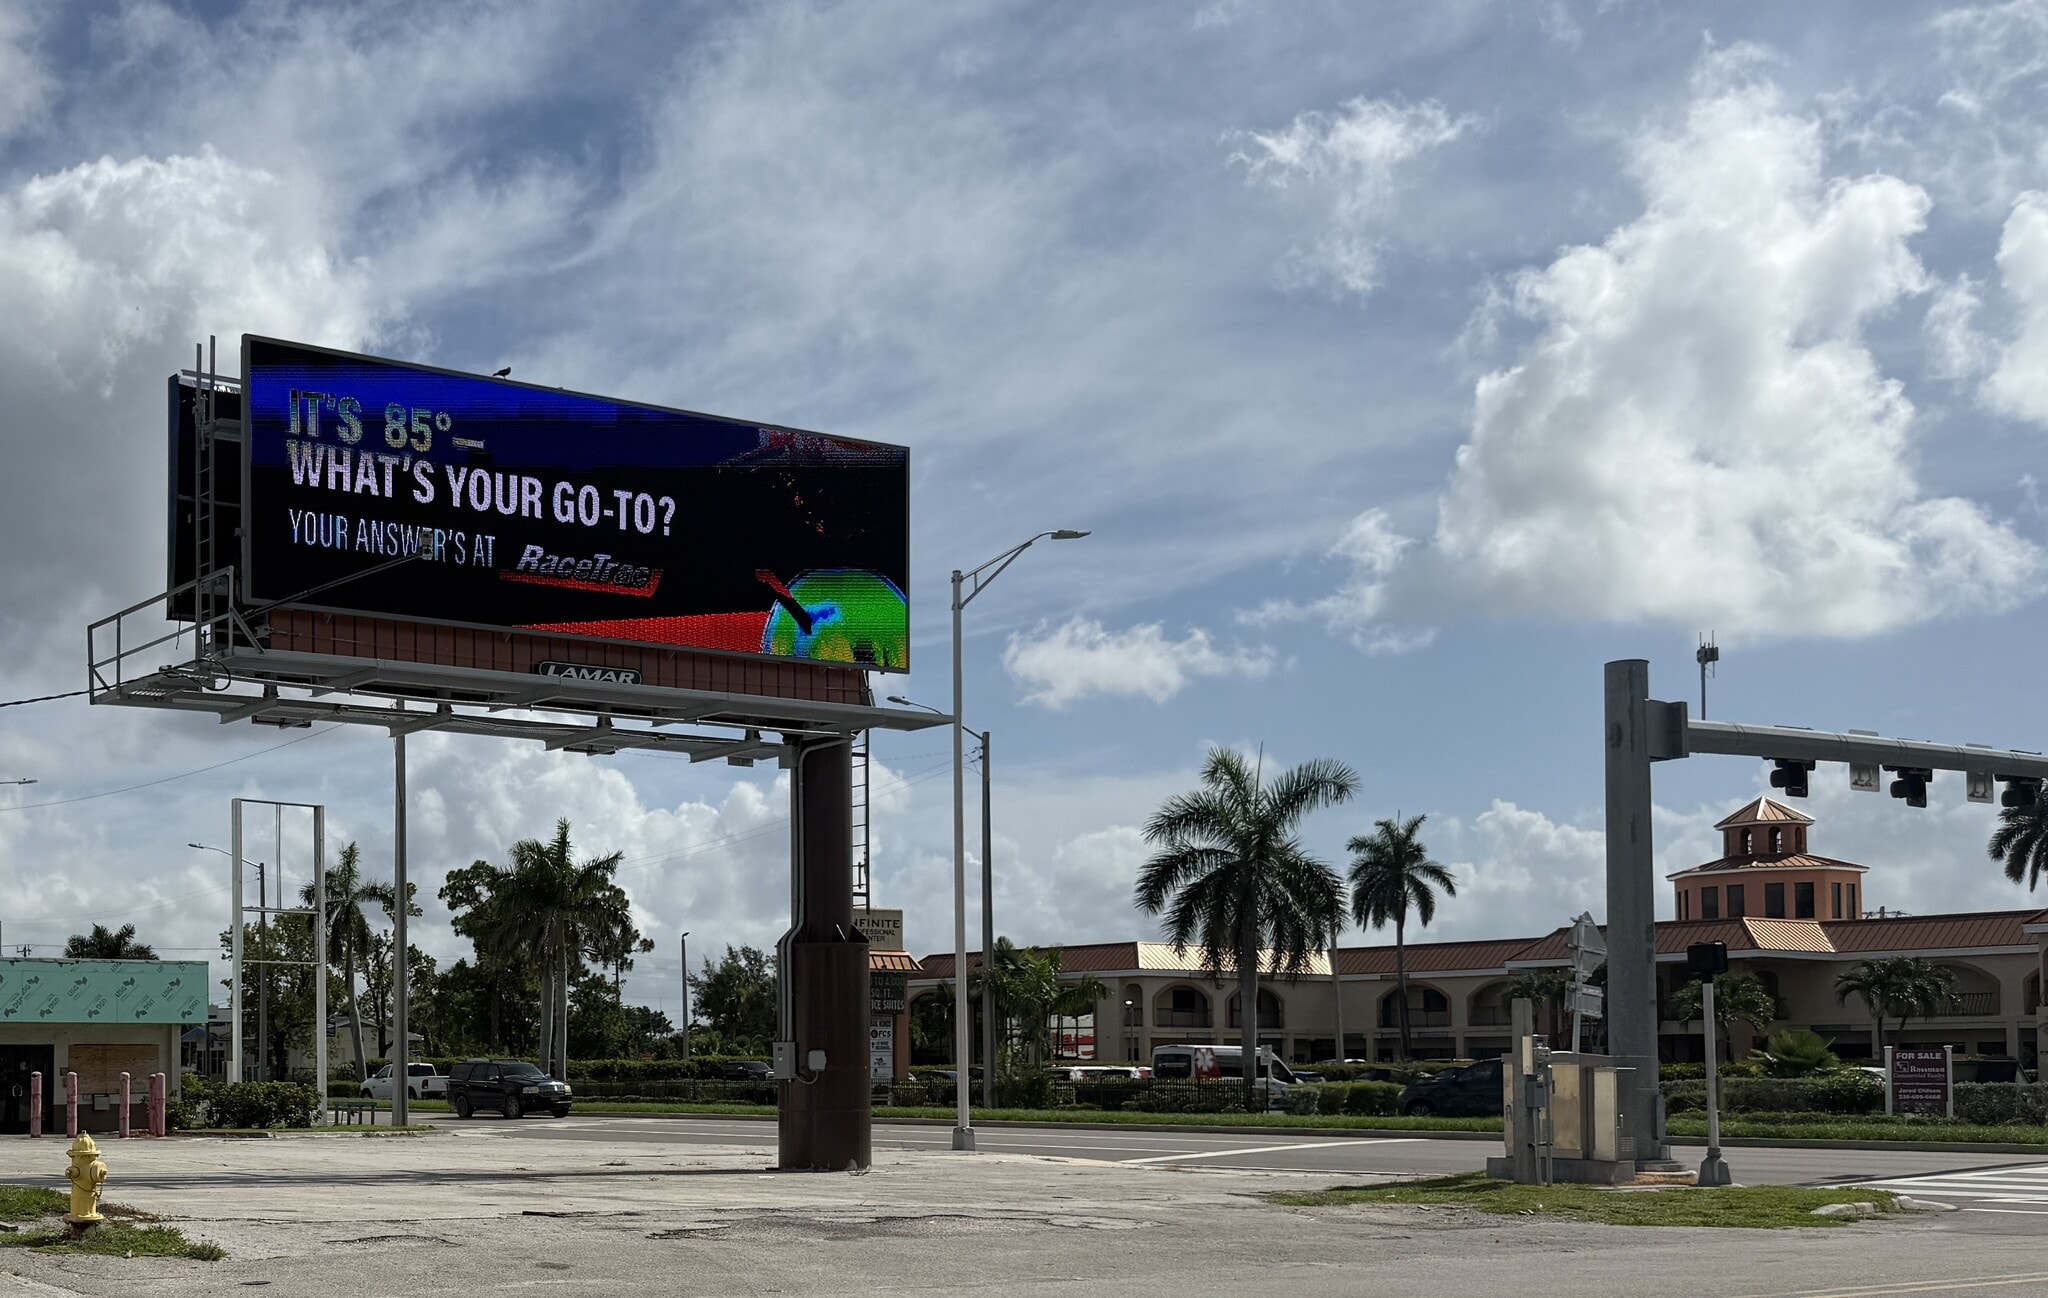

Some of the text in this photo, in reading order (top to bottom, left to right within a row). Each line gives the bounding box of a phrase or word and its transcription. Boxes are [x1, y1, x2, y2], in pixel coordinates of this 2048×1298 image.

[288, 388, 364, 445] IT'S
[286, 438, 676, 536] WHAT'S YOUR GO-TO?
[288, 508, 348, 550] YOUR
[472, 534, 496, 568] AT
[516, 544, 651, 587] RaceTrac
[547, 664, 635, 684] LAMAR
[853, 918, 900, 929] NFINITE
[861, 928, 896, 937] FESSIONAL
[870, 999, 881, 1010] ICE
[879, 1030, 891, 1038] FCS
[1895, 1052, 1942, 1060] FOR SALE
[1910, 1065, 1945, 1073] Rossman
